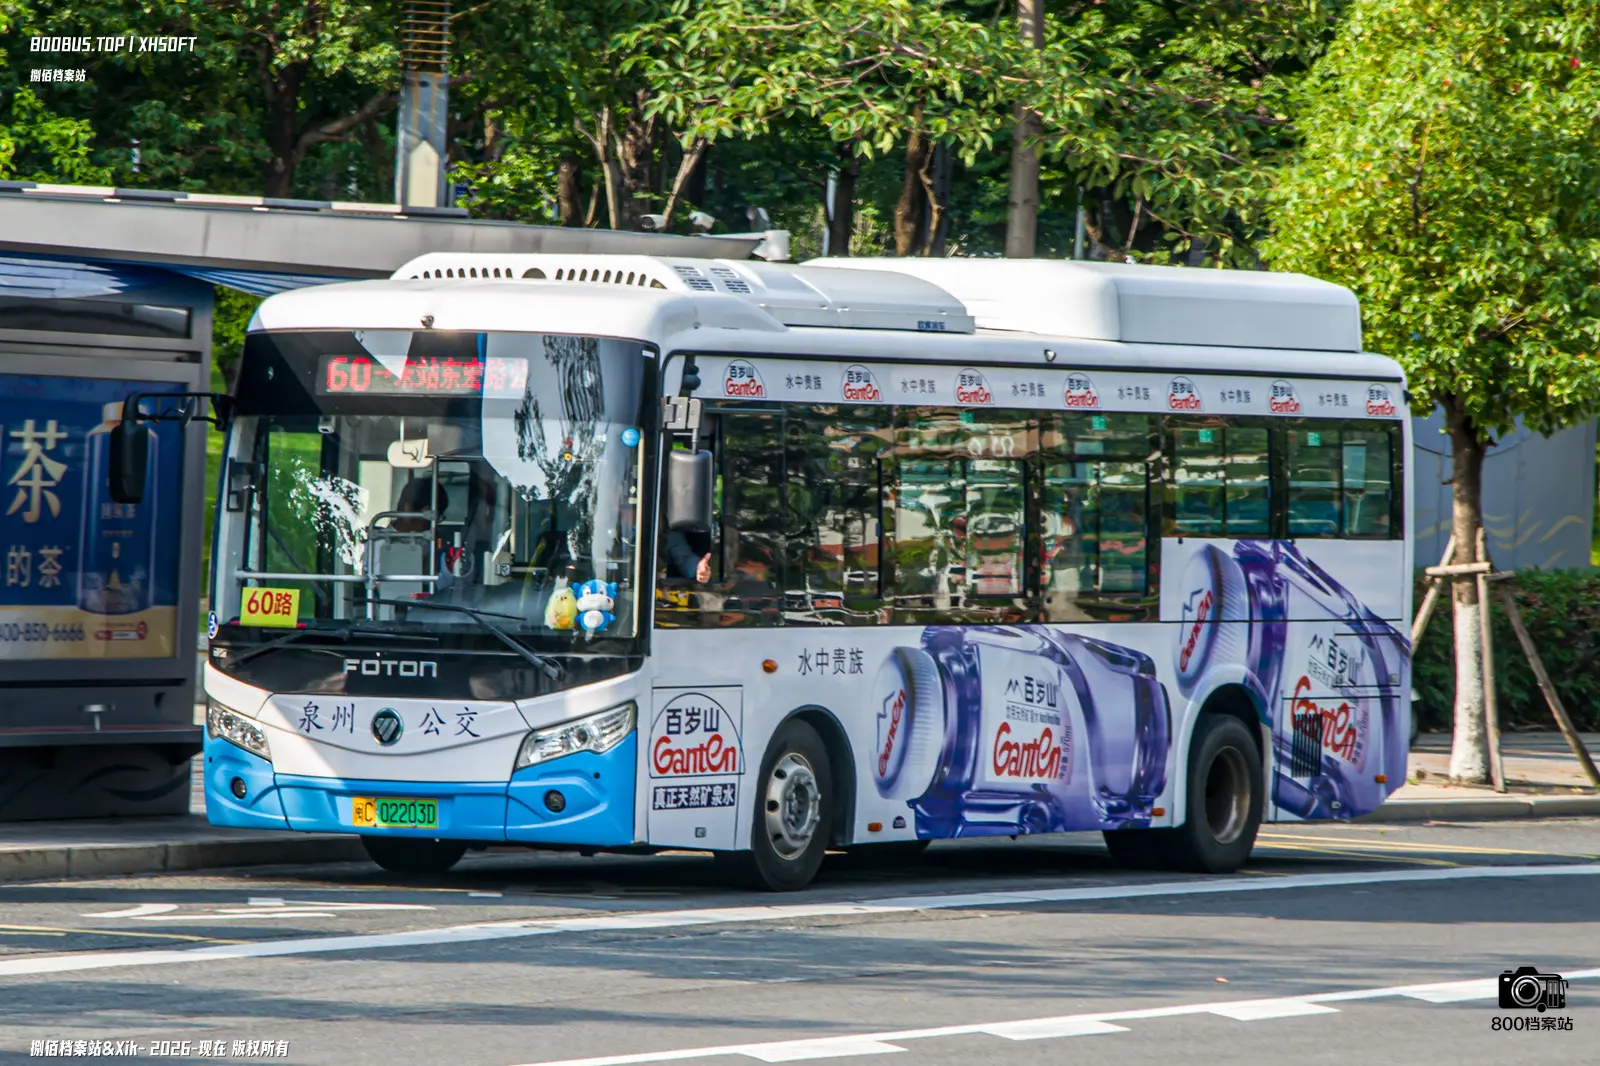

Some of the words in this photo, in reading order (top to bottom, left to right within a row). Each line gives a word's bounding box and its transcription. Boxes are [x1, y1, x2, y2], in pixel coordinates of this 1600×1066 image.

[327, 357, 372, 392] 60
[730, 365, 755, 379] 百岁山
[785, 374, 823, 391] 水中贵族
[847, 370, 871, 383] 百岁山
[960, 374, 983, 386] 百岁山
[901, 378, 937, 395] 水中贵族
[1011, 382, 1046, 398] 水中贵族
[0, 419, 68, 523] 茶
[6, 545, 63, 588] 的茶
[247, 591, 293, 616] 60路
[0, 622, 84, 642] 00-850-6666
[343, 658, 438, 678] FOTON
[798, 647, 864, 676] 水中贵族
[299, 701, 355, 734] 泉州
[418, 706, 481, 738] 公交
[666, 707, 720, 735] 百岁山
[654, 784, 735, 809] 真正天然矿泉水
